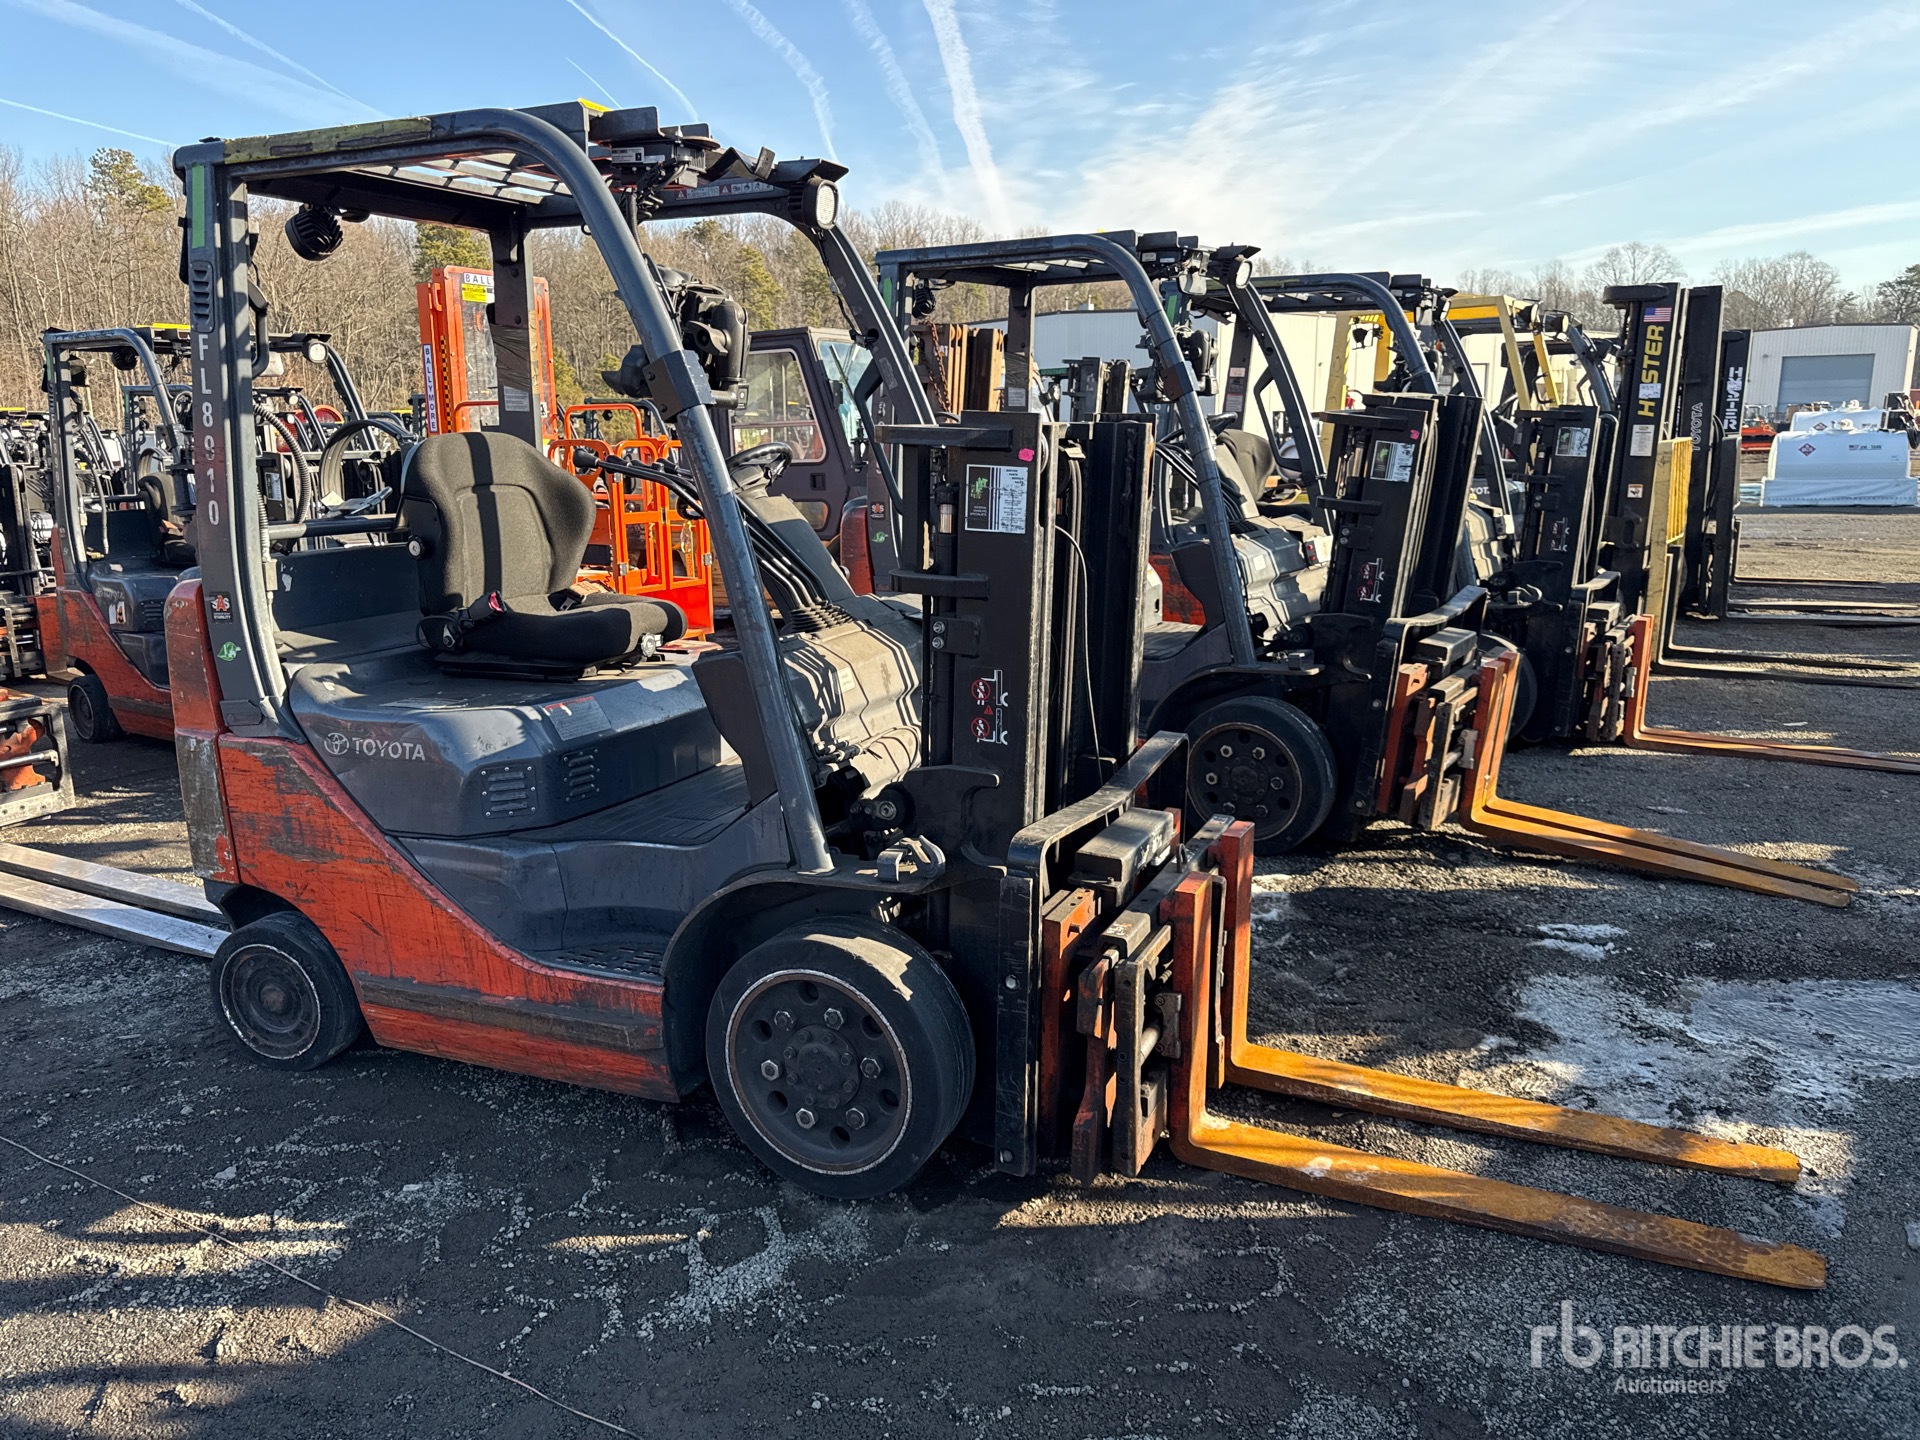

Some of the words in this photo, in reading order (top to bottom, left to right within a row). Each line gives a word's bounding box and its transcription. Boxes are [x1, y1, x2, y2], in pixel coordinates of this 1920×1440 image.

[465, 273, 492, 286] BALL
[425, 347, 437, 430] BALLYMORE
[1637, 325, 1664, 417] HSTER
[1723, 366, 1744, 430] HSTER
[198, 333, 220, 526] FL8910
[211, 595, 231, 612] SAS
[352, 737, 426, 761] TOYOTA
